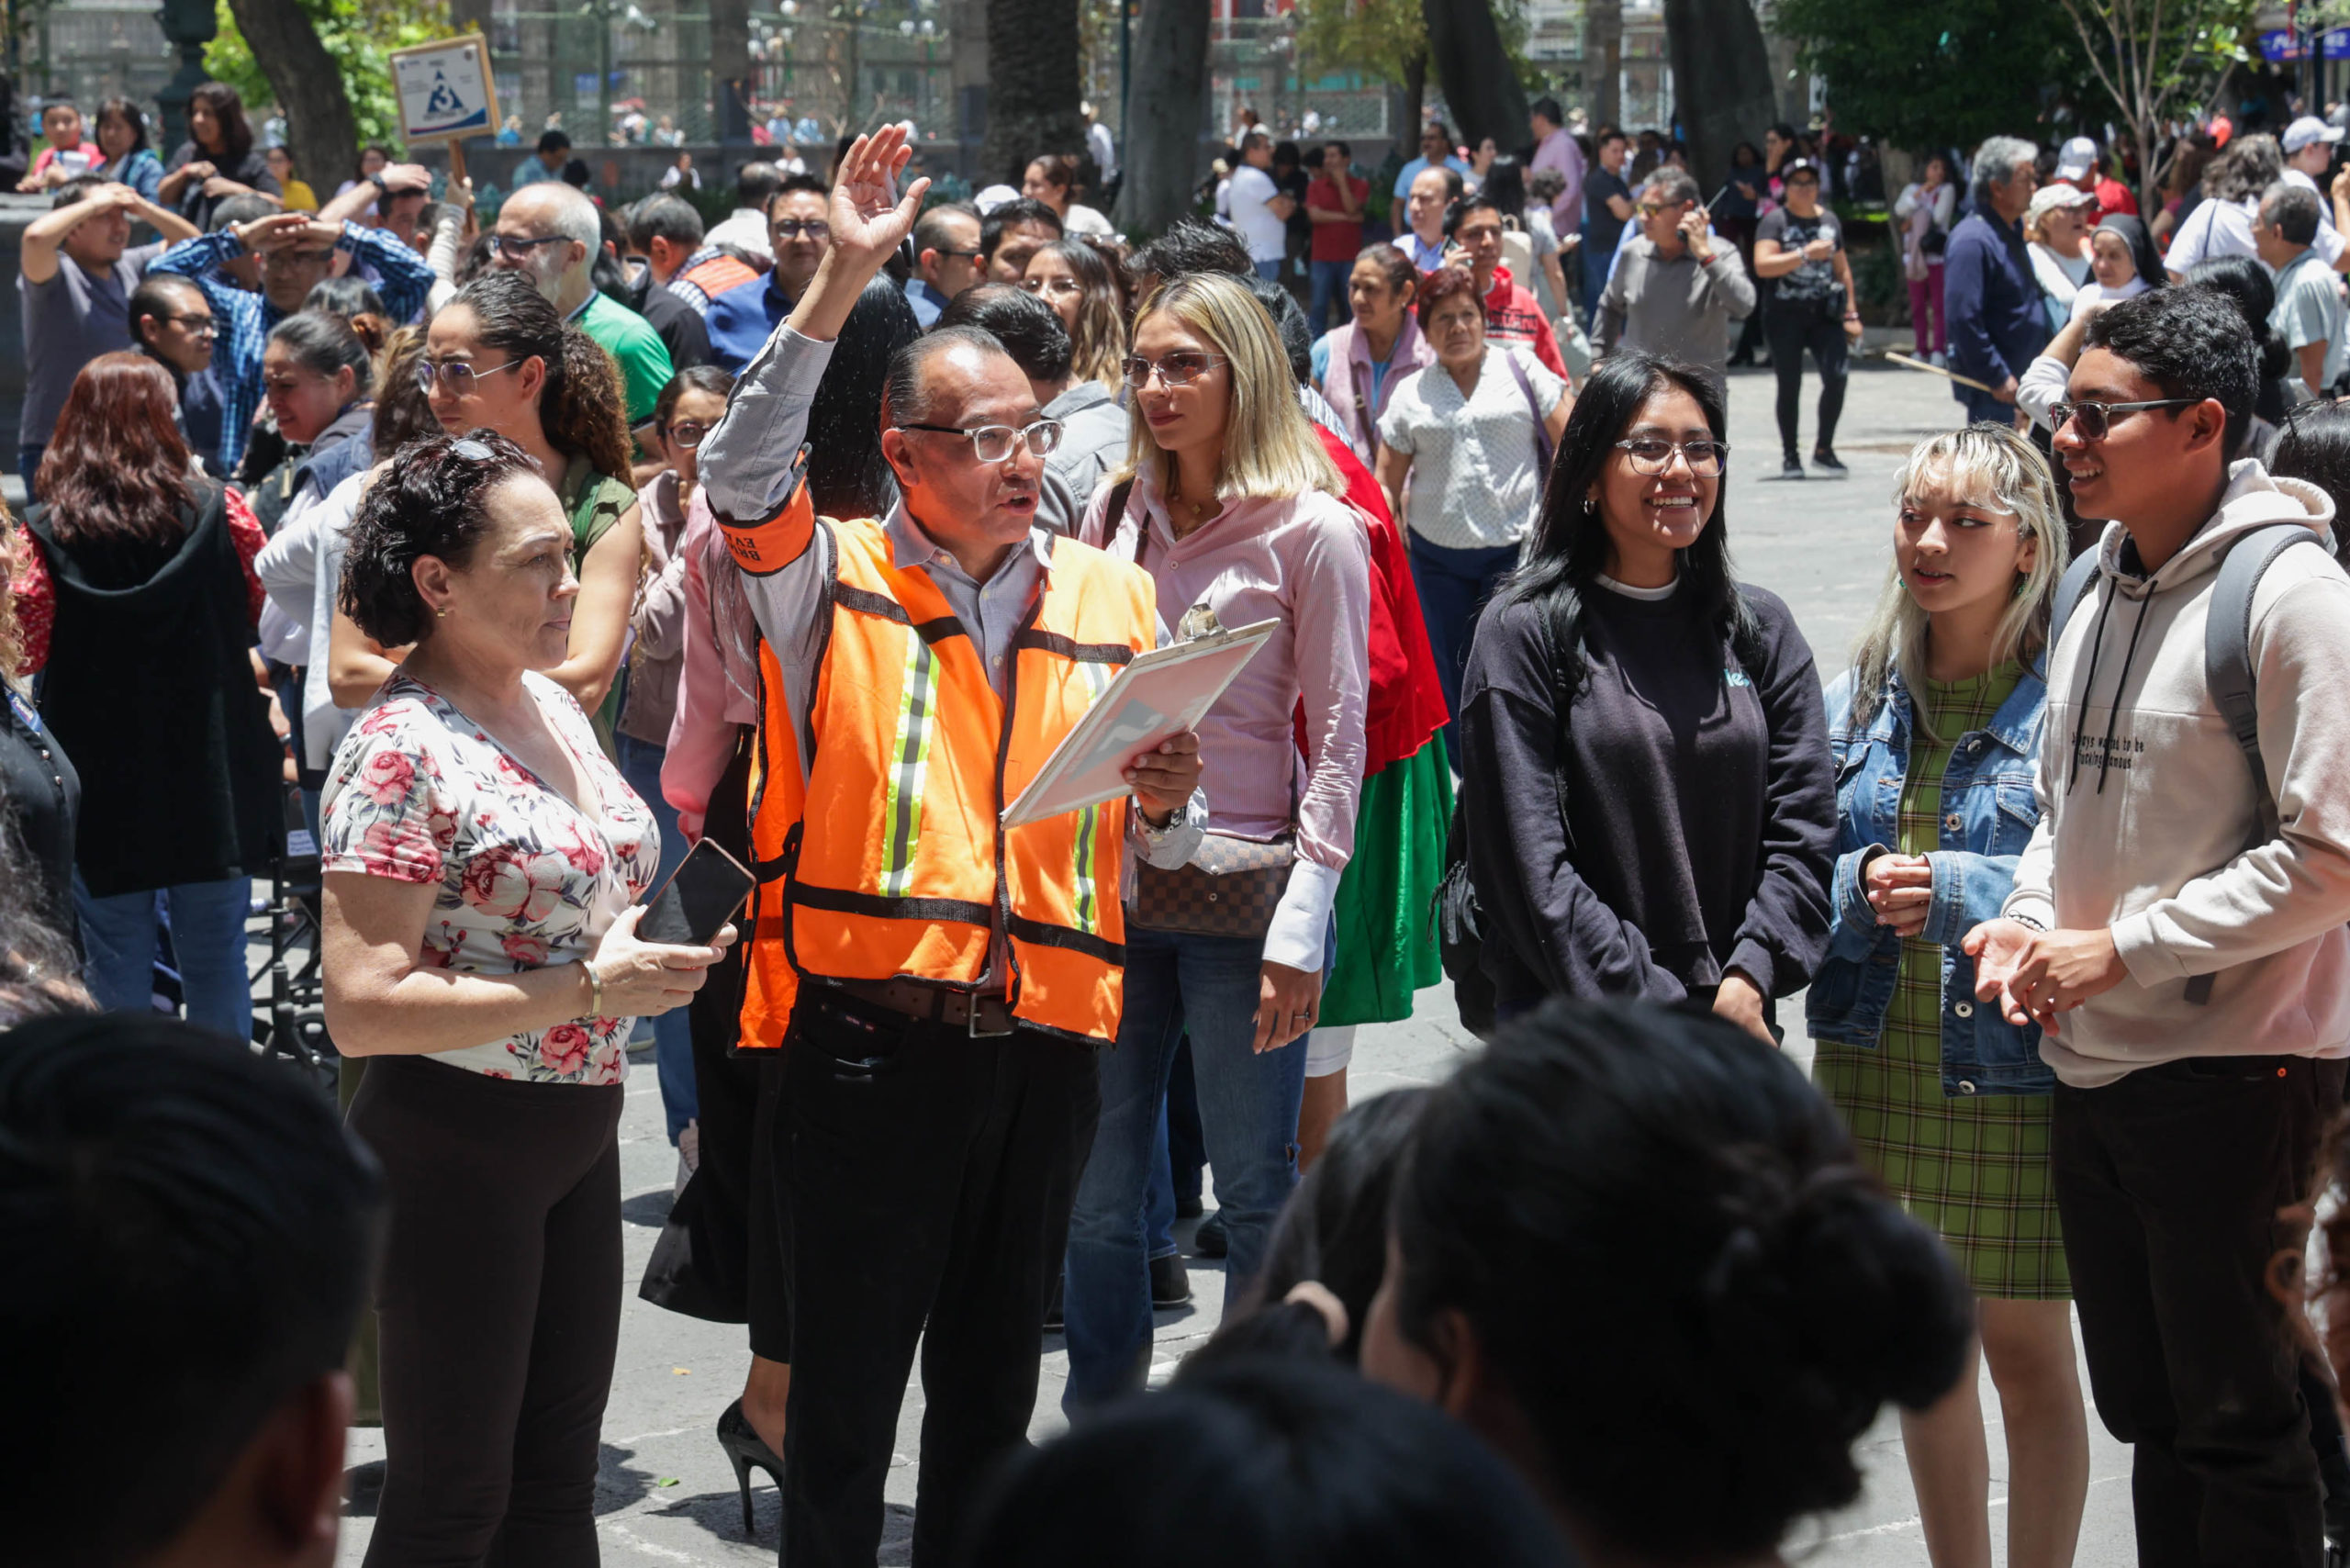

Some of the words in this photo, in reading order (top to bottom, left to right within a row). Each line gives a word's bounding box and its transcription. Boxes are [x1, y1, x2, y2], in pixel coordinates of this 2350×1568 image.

[434, 79, 454, 110] 3
[2134, 735, 2144, 753] be
[2109, 756, 2131, 769] amous
